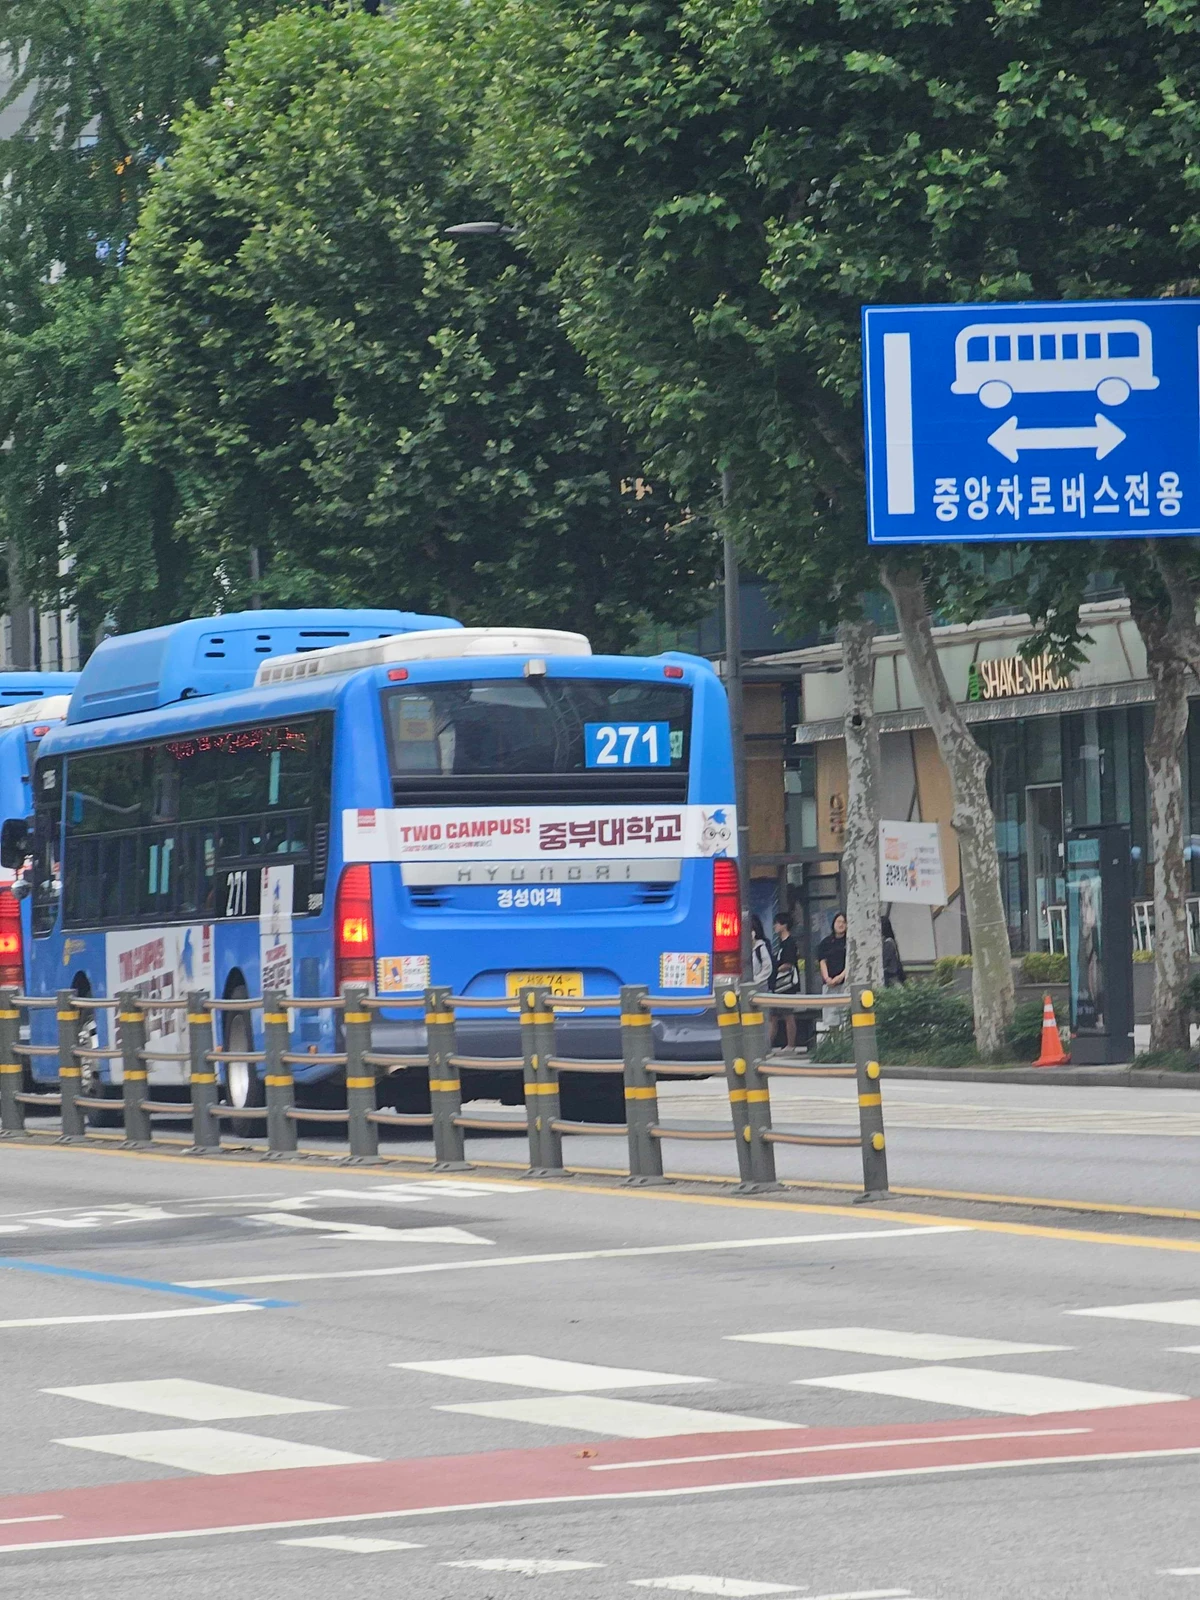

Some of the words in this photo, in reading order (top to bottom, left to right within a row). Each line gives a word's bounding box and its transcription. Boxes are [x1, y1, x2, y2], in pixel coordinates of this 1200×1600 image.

[933, 471, 1183, 522] 중앙차로버스전용
[981, 655, 1025, 699] SHAKE
[596, 725, 658, 765] 271
[400, 824, 441, 842] TWO
[446, 817, 531, 840] CAMPUS!
[539, 814, 681, 851] 중부대학교
[457, 864, 631, 882] HYUNDAI
[226, 871, 248, 916] 271
[497, 888, 562, 908] 경성여객
[546, 974, 563, 985] 74
